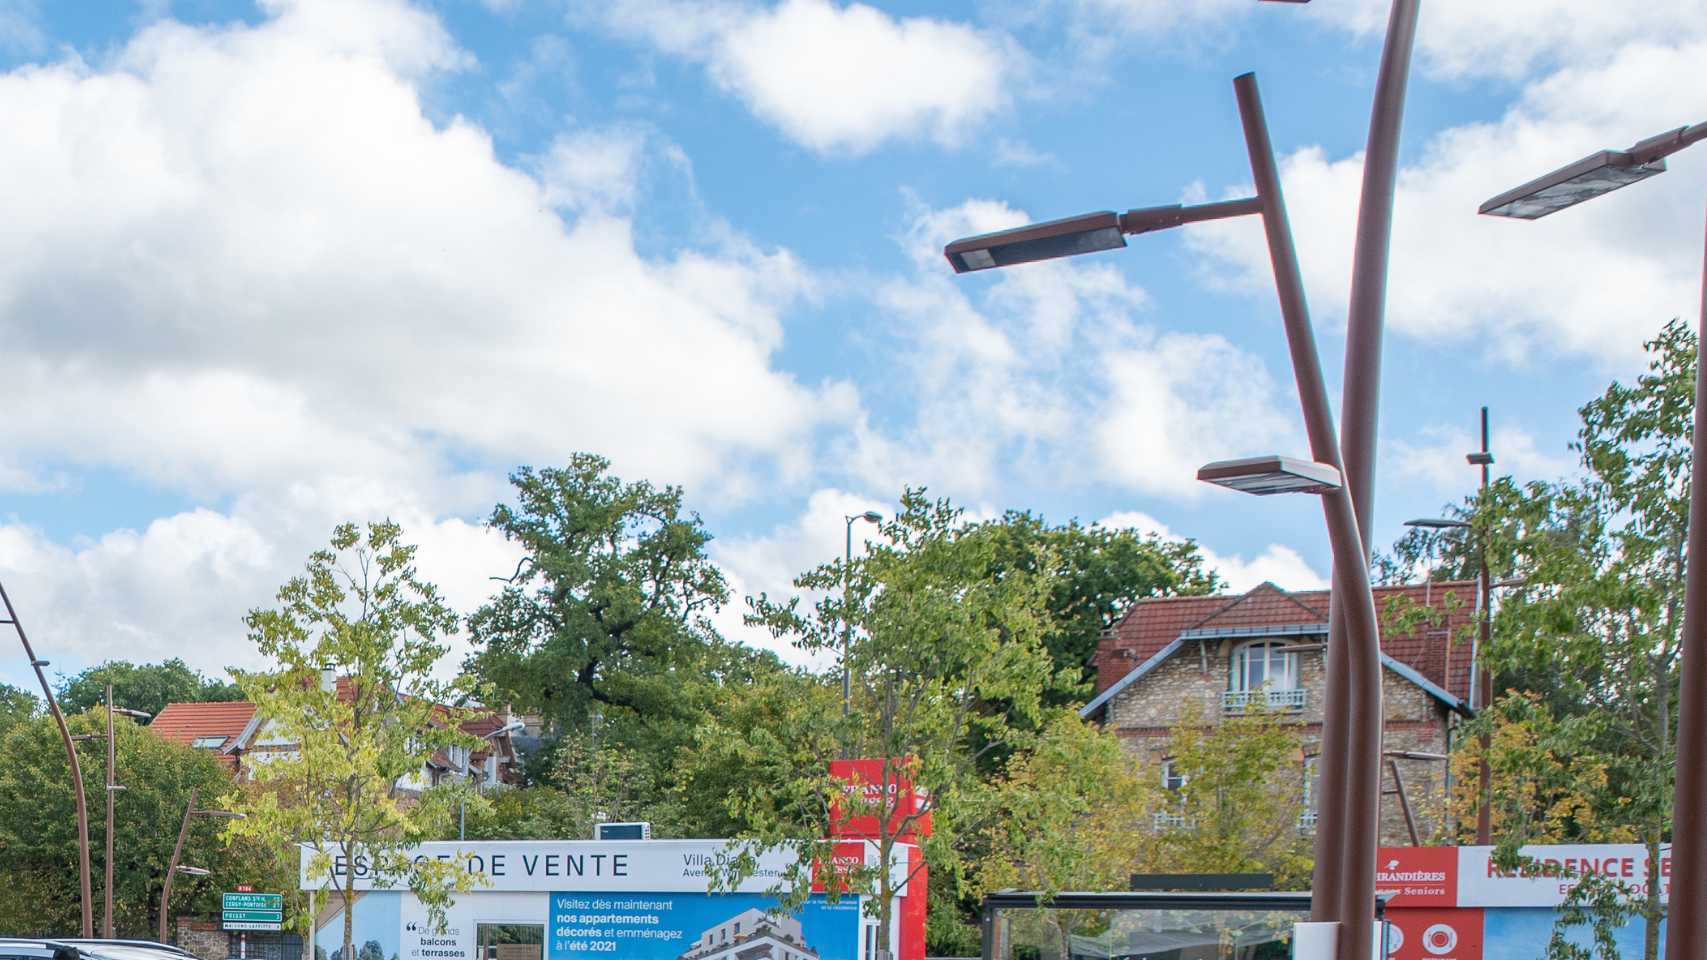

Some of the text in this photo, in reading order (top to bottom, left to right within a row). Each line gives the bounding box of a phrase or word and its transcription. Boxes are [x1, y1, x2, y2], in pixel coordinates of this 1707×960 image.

[467, 855, 506, 876] DE
[522, 855, 628, 876] VENTE
[683, 854, 756, 866] Villa Diaa
[1404, 887, 1445, 895] Seniors
[557, 899, 673, 911] Visitez dès maintenant
[557, 914, 659, 926] nos appartements
[418, 926, 430, 935] De
[556, 927, 683, 941] décorés et emménagez
[420, 938, 457, 946] balcons
[556, 941, 617, 952] à l'été 2021
[411, 949, 466, 958] et terrasses
